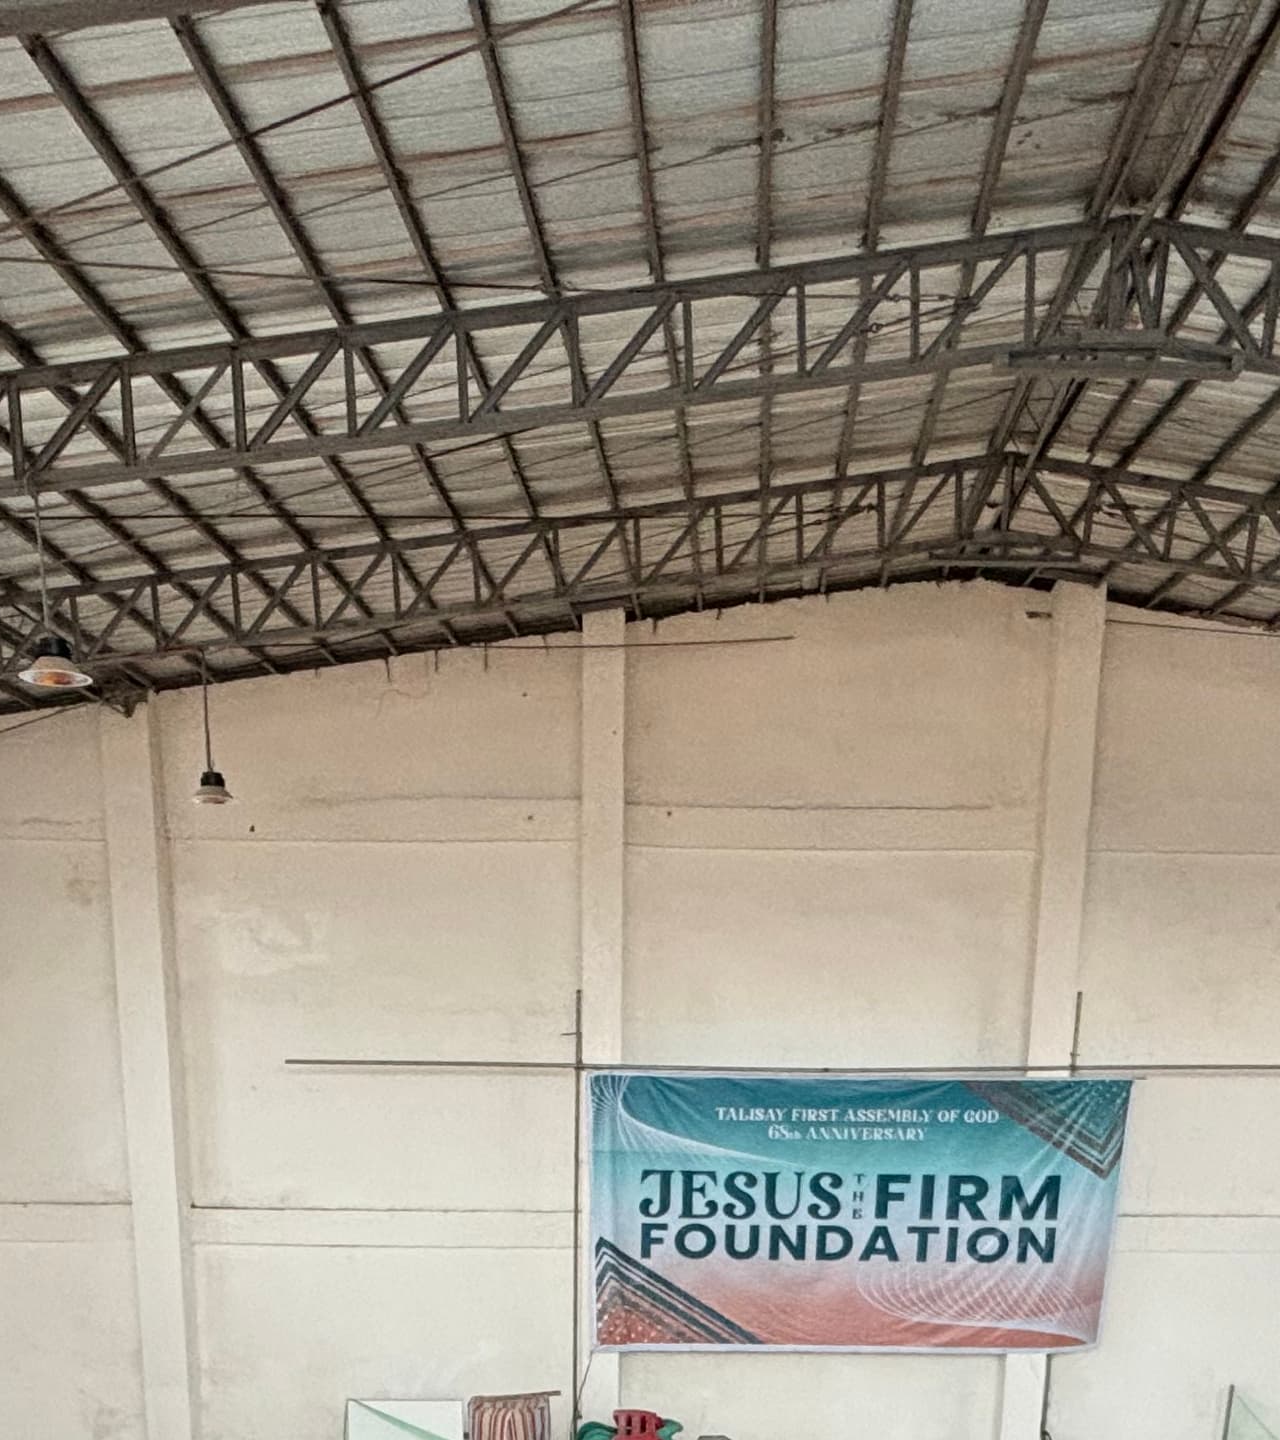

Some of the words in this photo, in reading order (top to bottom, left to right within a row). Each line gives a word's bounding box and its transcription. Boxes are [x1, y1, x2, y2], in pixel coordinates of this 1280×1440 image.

[716, 1107, 787, 1122] TALISAY
[791, 1108, 839, 1122] FIRST
[844, 1109, 933, 1123] ASSEMBLY
[938, 1109, 960, 1123] OF
[964, 1109, 1000, 1124] GOD
[806, 1127, 927, 1142] ANNIVERSARY
[638, 1169, 843, 1220] JESUS
[852, 1173, 865, 1220] THE
[874, 1174, 1062, 1221] FIRM
[640, 1222, 1057, 1264] FOUNDATION
